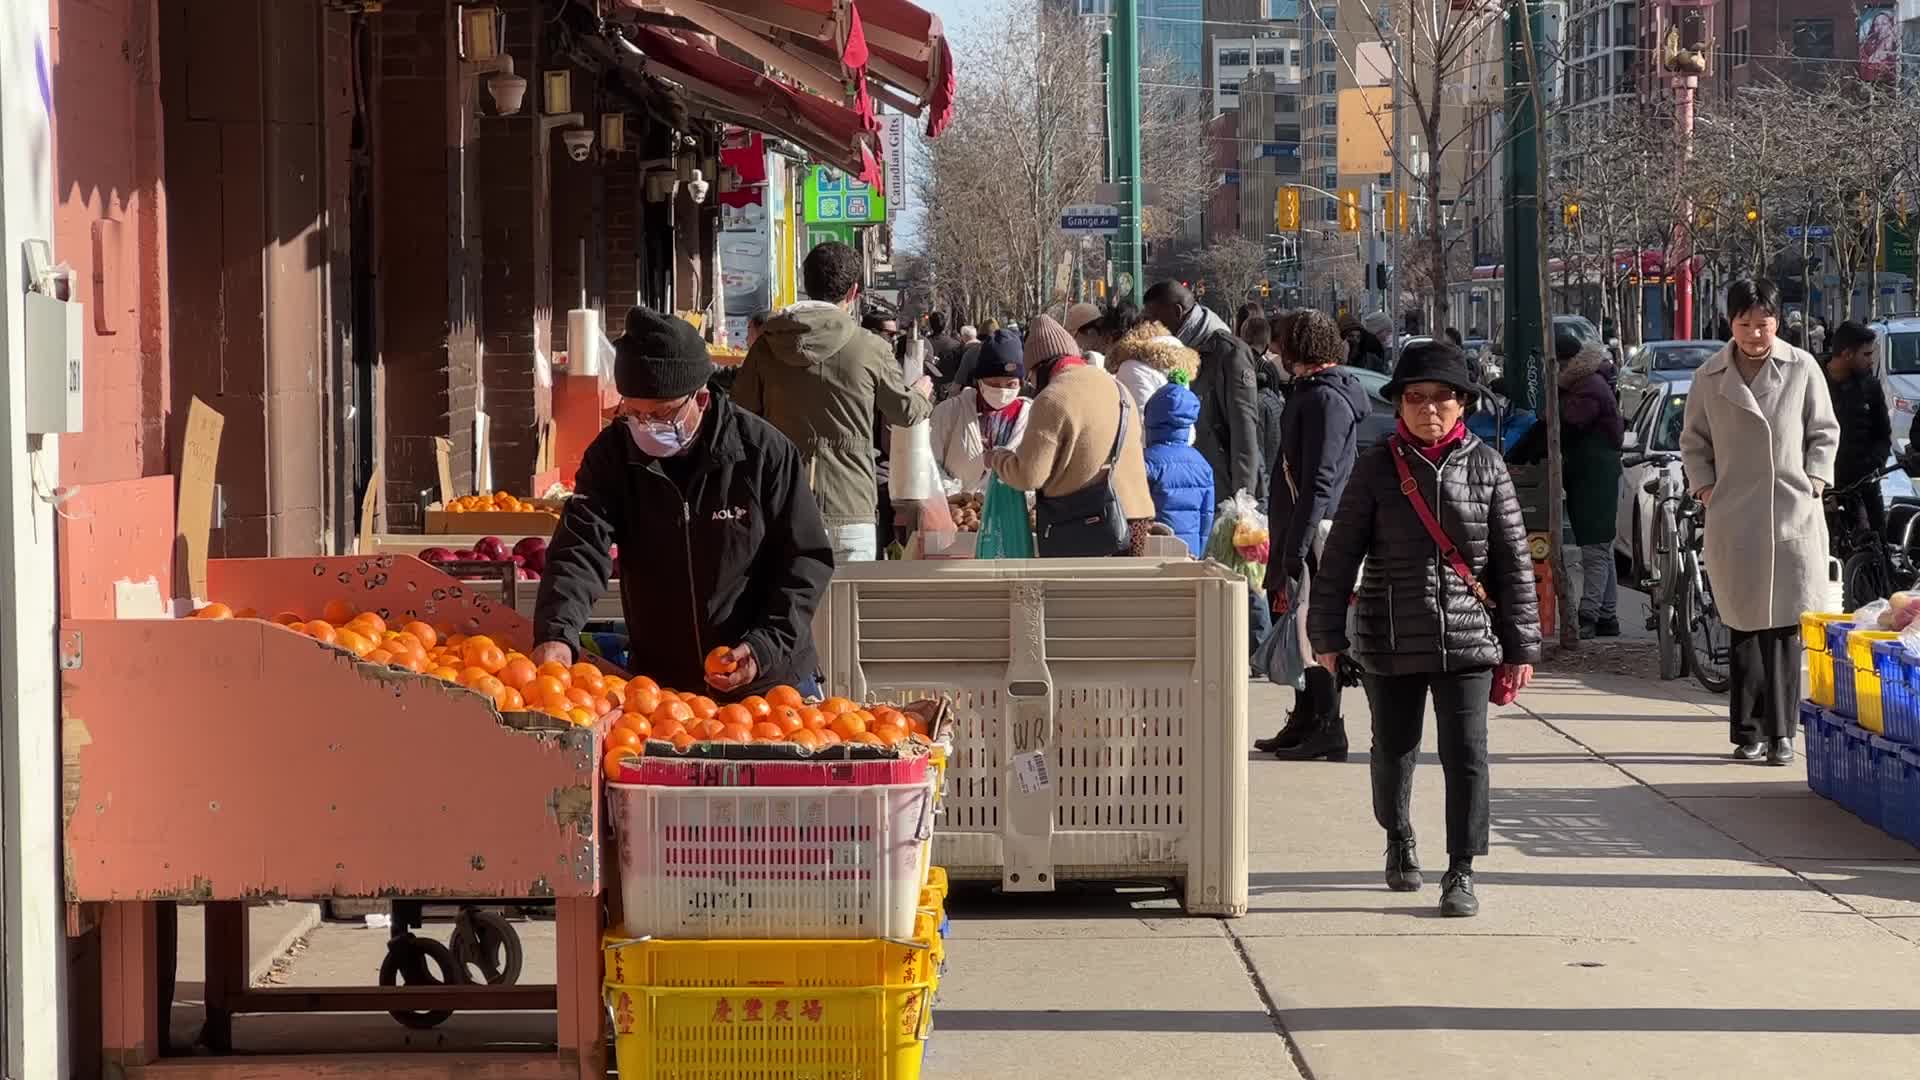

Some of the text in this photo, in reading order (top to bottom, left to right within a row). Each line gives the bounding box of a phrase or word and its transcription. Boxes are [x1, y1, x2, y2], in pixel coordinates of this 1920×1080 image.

[888, 117, 901, 206] Canadian Gifts
[1067, 216, 1098, 228] Grange
